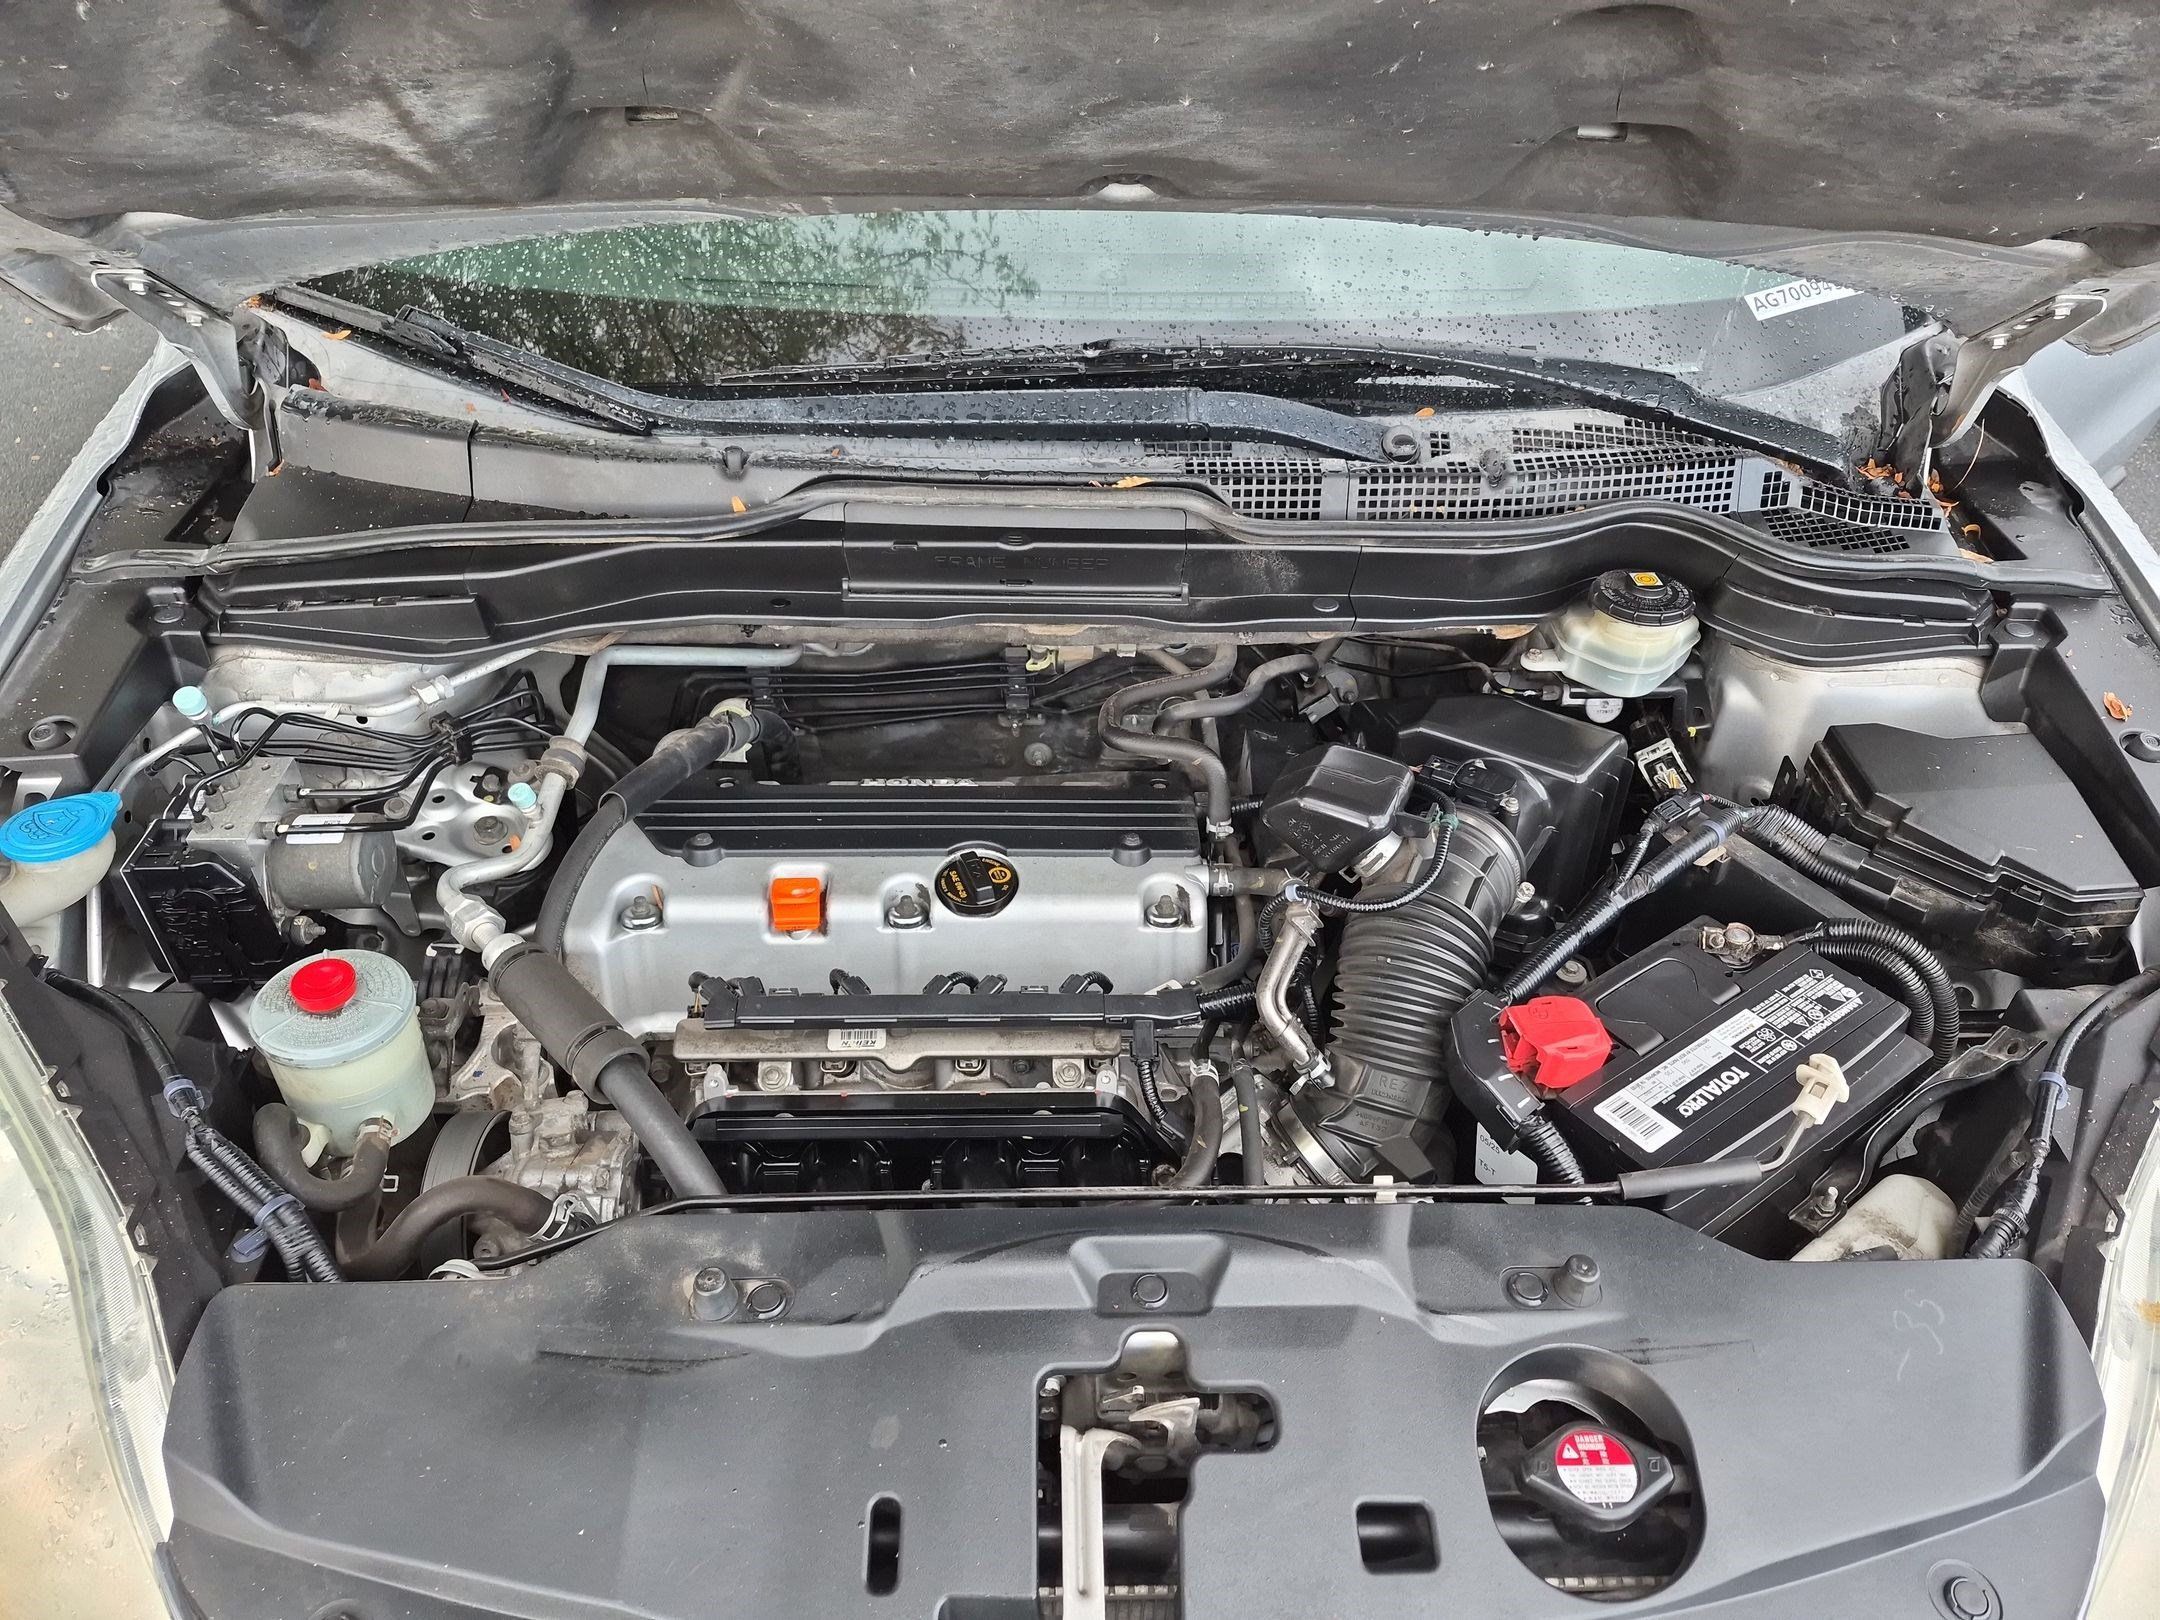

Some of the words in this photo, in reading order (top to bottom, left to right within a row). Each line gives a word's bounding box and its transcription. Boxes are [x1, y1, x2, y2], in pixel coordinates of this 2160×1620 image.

[1753, 281, 1841, 312] AG70094
[860, 777, 978, 787] HONDA
[949, 870, 960, 883] SAE
[1378, 1075, 1409, 1092] REZ
[1675, 1066, 1750, 1117] TOTALPRO
[1479, 1134, 1500, 1154] 05/25
[1478, 1158, 1497, 1176] T5-T
[1573, 1434, 1604, 1442] DANGER
